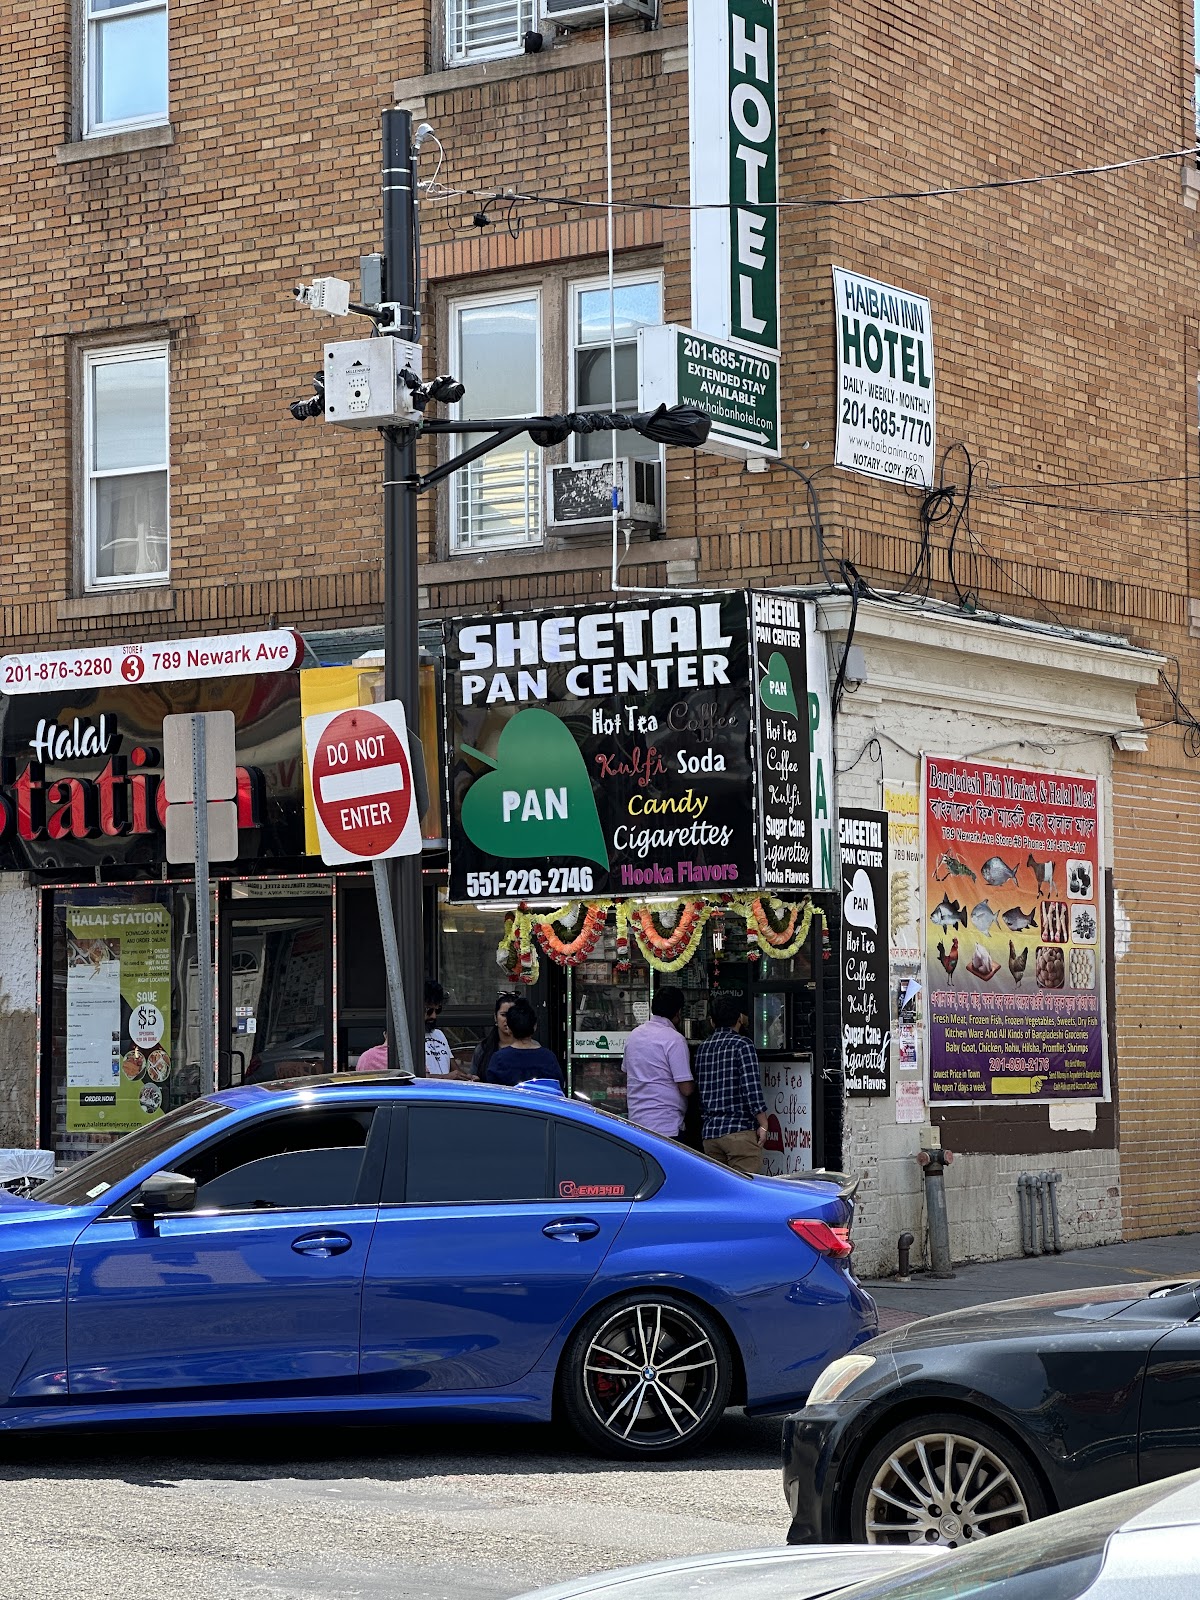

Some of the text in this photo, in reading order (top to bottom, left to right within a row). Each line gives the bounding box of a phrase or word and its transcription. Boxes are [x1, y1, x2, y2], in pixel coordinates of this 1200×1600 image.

[731, 13, 771, 334] HOTEL
[844, 279, 924, 334] HAIBAN INN
[683, 337, 770, 380] 201-685-7770
[841, 314, 931, 389] HOTEL
[687, 362, 767, 395] EXTENDED STAY
[699, 381, 757, 407] AVAILABLE
[843, 375, 931, 415] DAILY WEEKLY MONTHLY
[682, 395, 773, 430] www.haibanhotel.com
[842, 397, 932, 448] 201-685-7770
[848, 434, 925, 464] www.haibaninn.com
[853, 452, 881, 471] NOTARY
[884, 461, 901, 476] COPY
[755, 596, 800, 629] SHEETAL
[122, 645, 138, 655] STORE
[458, 603, 732, 671] SHEETAL
[756, 625, 800, 648] PAN CENTER
[5, 642, 289, 684] 201-876-3280 3 789 Newark Ave
[462, 654, 731, 706] PAN CENTER
[769, 680, 787, 696] PAN
[592, 700, 738, 743] Hot Tea Coffee
[765, 718, 797, 743] Hot Tea
[29, 713, 113, 764] Halal
[327, 735, 386, 767] DO NOT
[595, 746, 727, 786] Kulfi Soda
[766, 746, 799, 781] Coffee
[768, 783, 802, 814] Kulfi
[808, 692, 832, 888] PAN
[929, 764, 1095, 809] Bangladesh Fish Market & Halal Meat
[340, 802, 392, 831] ENTER
[502, 786, 568, 823] PAN
[628, 789, 708, 818] Candy
[613, 821, 733, 858] Cigarettes
[766, 815, 806, 840] Sugar Cane
[839, 818, 883, 848] SHEETAL
[956, 828, 980, 843] Newark
[981, 832, 994, 845] Ave
[995, 832, 1013, 847] Store
[1022, 836, 1045, 851] Phone:
[841, 847, 883, 868] PAN CENTER
[466, 866, 594, 898] 551-226-2746
[621, 861, 739, 886] Hooka Flavors
[785, 868, 810, 885] Flavors
[853, 896, 869, 911] PAN
[71, 911, 163, 927] HALAL STATION
[846, 931, 876, 954] Hot Tea
[846, 957, 876, 991] Coffee
[136, 990, 157, 1002] SAVE
[847, 993, 879, 1022] Kulfi
[138, 1006, 157, 1030] $5
[932, 1013, 949, 1024] Fresh
[950, 1013, 968, 1026] Meat,
[969, 1014, 989, 1025] Frozen
[1004, 1015, 1024, 1026] Frozen
[1077, 1016, 1087, 1028] Dry
[1087, 1016, 1098, 1026] Fish
[844, 1024, 881, 1049] Sugar Cane
[944, 1027, 1089, 1041] Kitchen Ware And All Kinds of Bangladeshi Groceries
[945, 1041, 960, 1054] Baby
[1067, 1042, 1089, 1054] Shrimps
[764, 1065, 803, 1090] Hot Tea
[863, 1075, 887, 1091] Flavors
[933, 1069, 949, 1079] Lowest
[949, 1069, 961, 1079] Price
[967, 1069, 981, 1078] Town
[933, 1082, 941, 1092] We
[941, 1083, 953, 1093] open
[958, 1082, 969, 1093] days
[973, 1082, 987, 1092] week
[774, 1091, 807, 1124] Coffee
[784, 1127, 811, 1151] Sugar Cane
